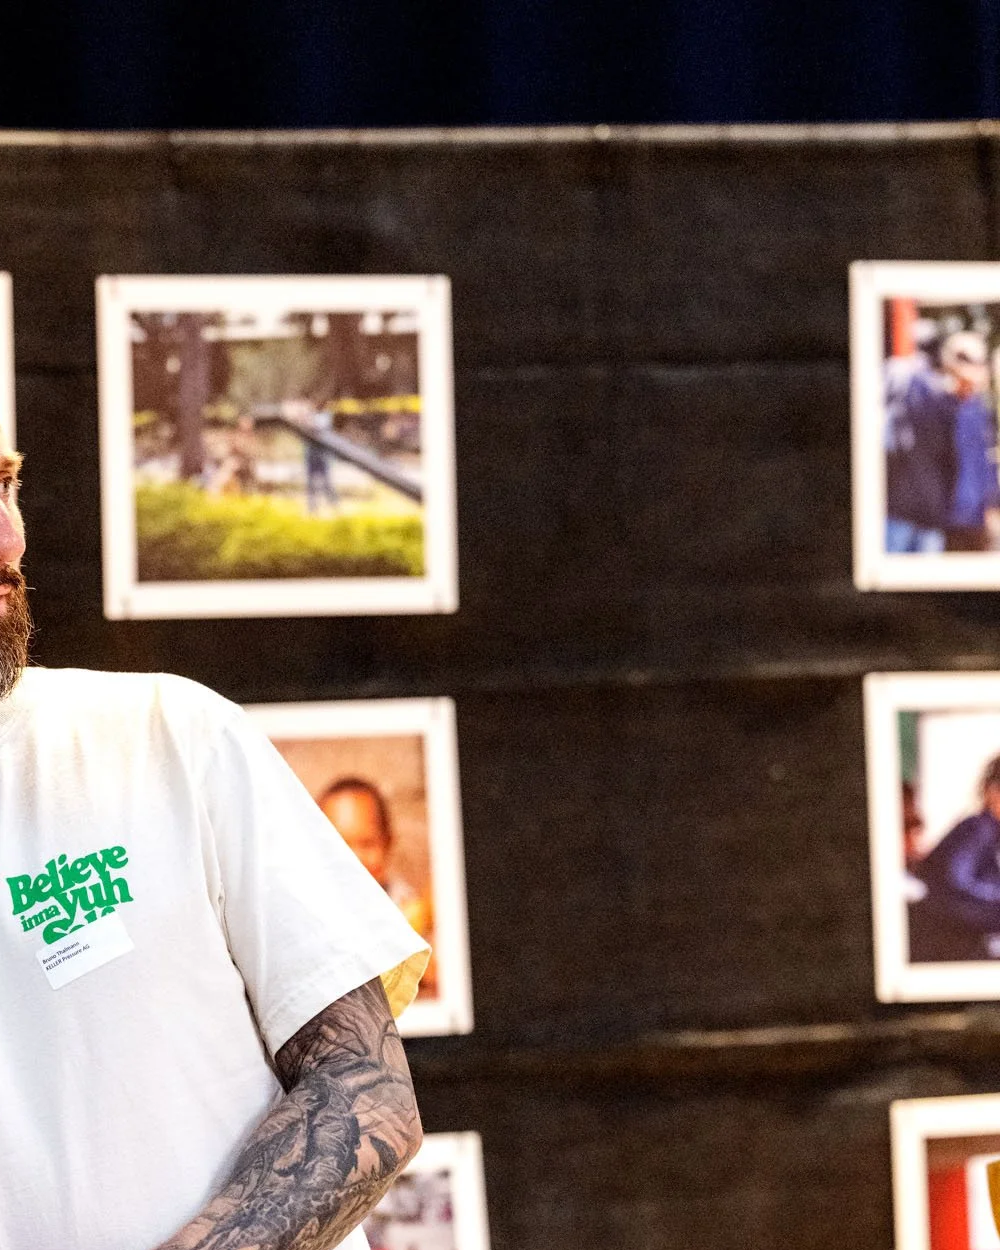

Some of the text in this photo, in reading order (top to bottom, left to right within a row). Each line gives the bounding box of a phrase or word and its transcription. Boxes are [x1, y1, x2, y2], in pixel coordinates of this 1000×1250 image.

[6, 846, 129, 915] Believe
[20, 904, 61, 932] inna
[56, 870, 134, 926] yuh
